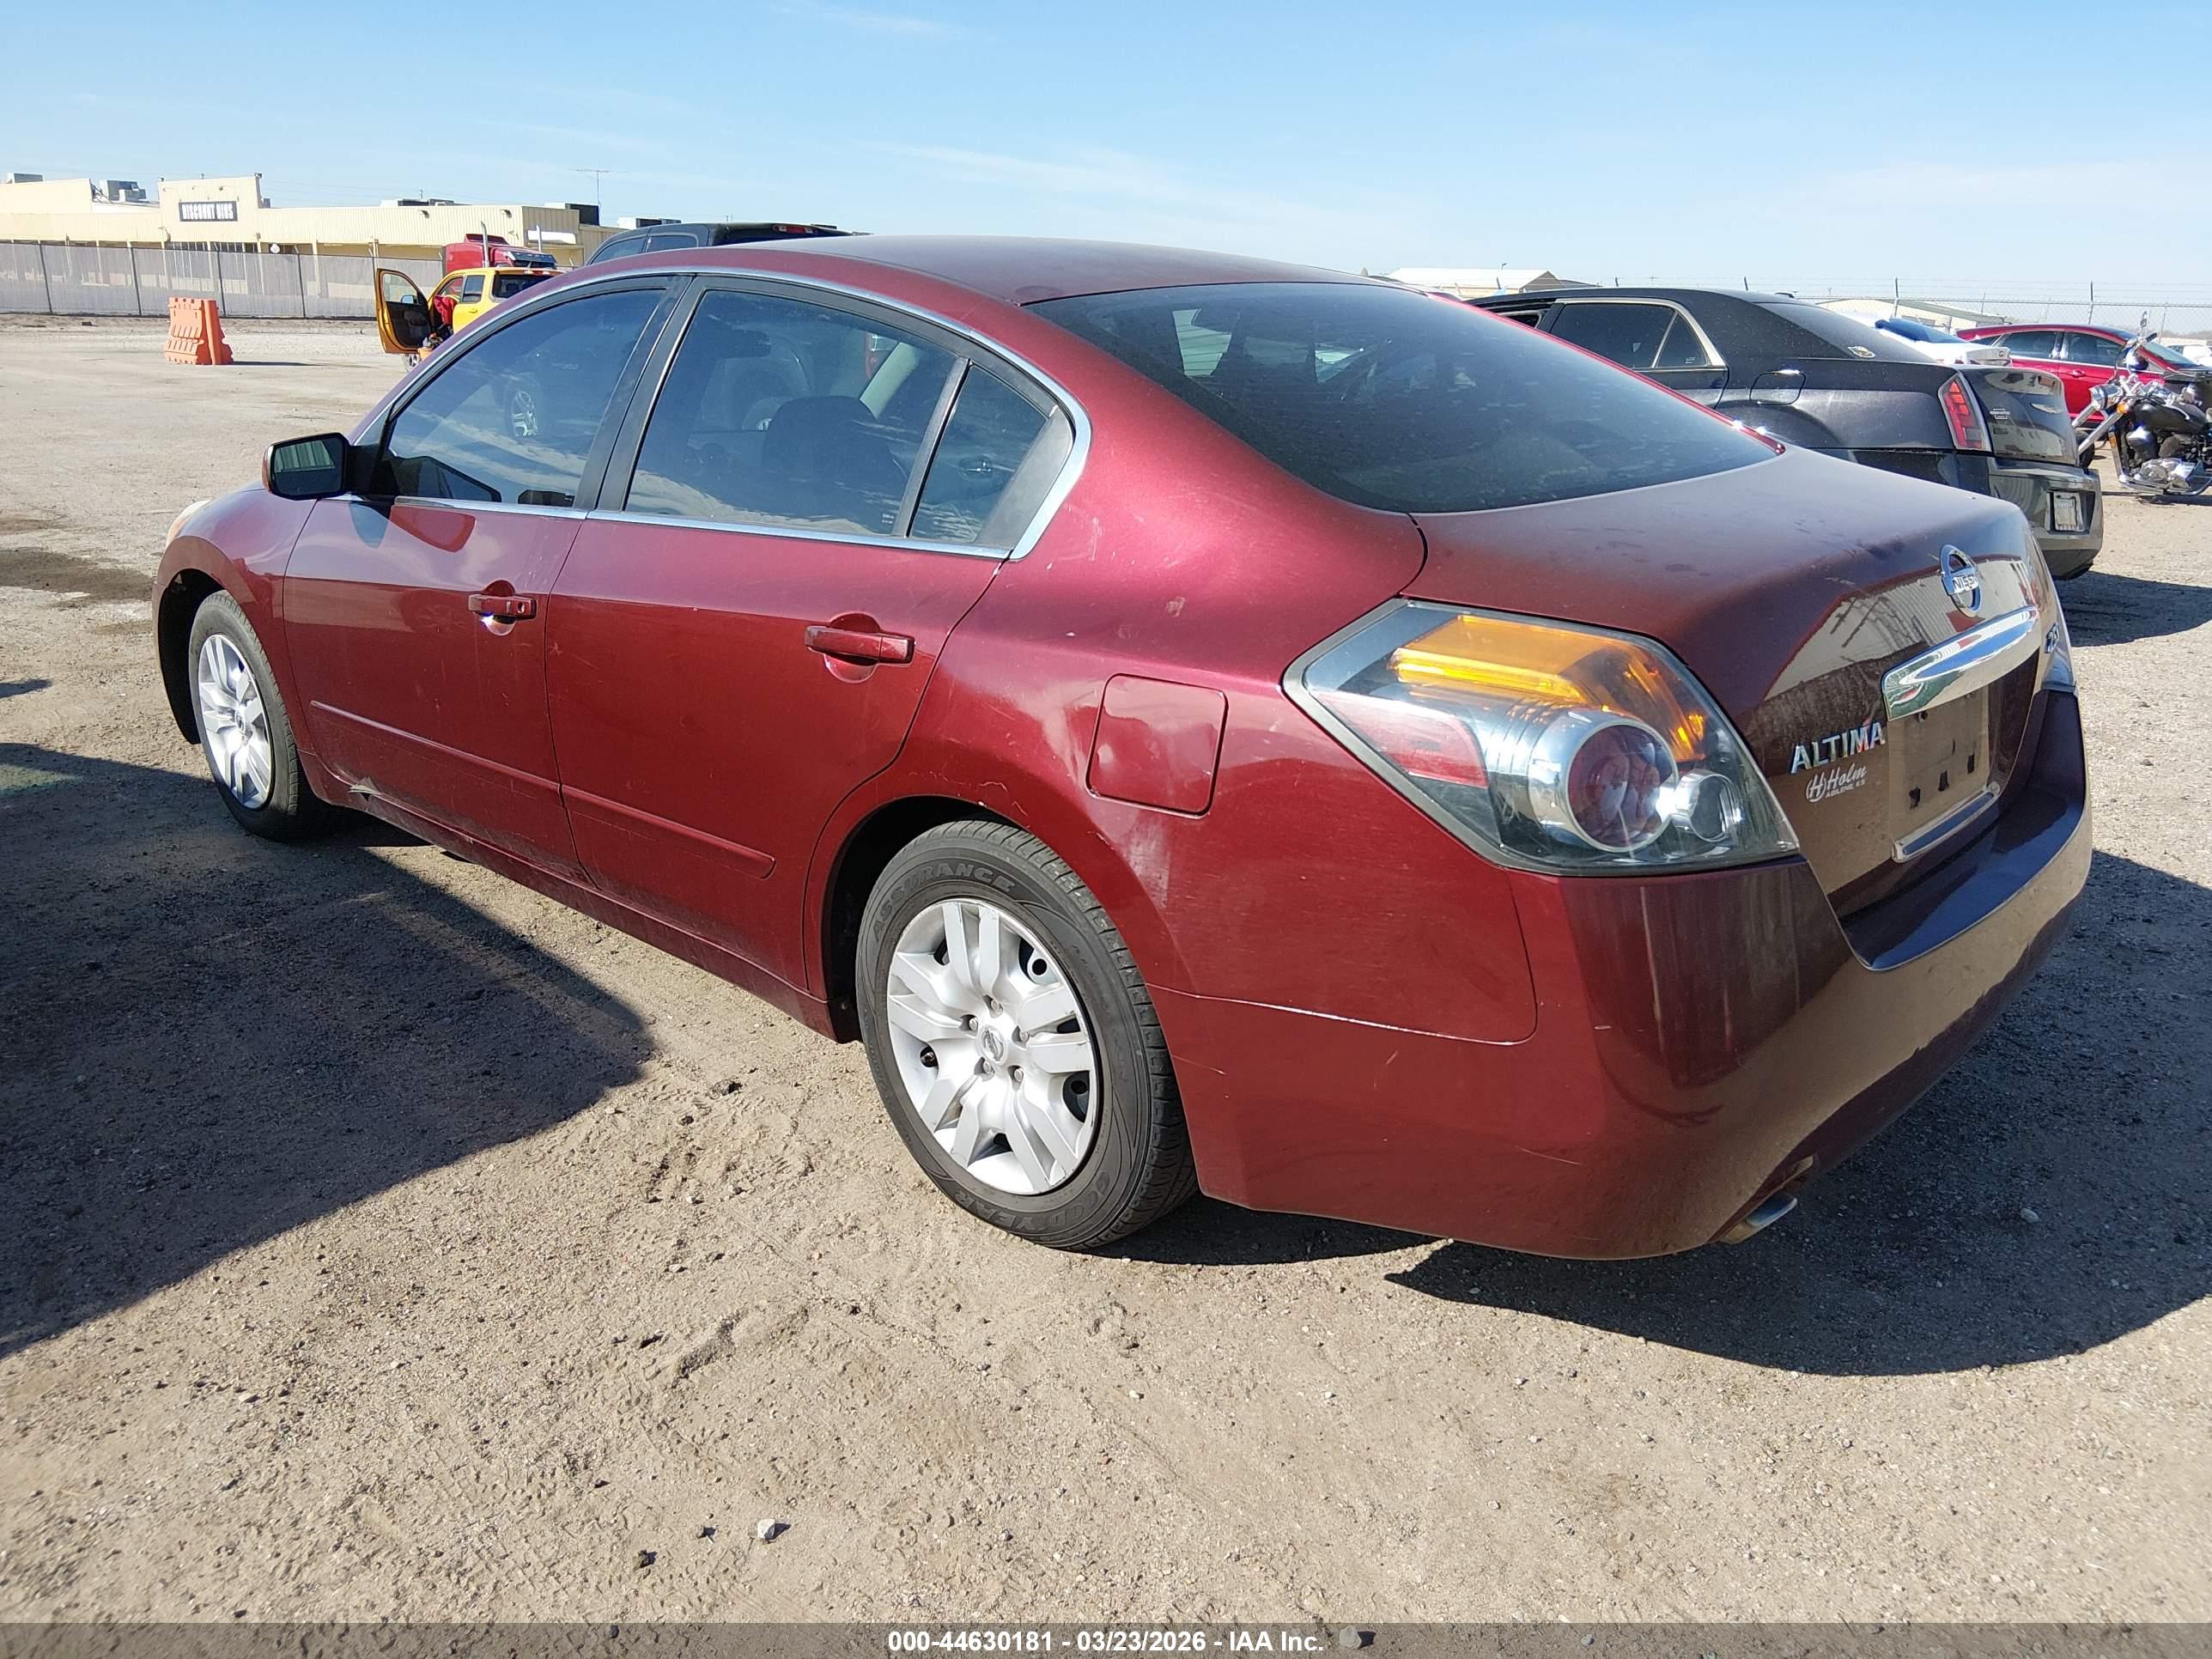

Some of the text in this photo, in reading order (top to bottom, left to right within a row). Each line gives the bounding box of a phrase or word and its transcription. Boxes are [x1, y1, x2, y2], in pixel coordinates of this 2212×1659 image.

[181, 204, 216, 220] DISCOUNT
[1790, 721, 1887, 775] ALTIMA
[873, 861, 1018, 943] ASSURANCE
